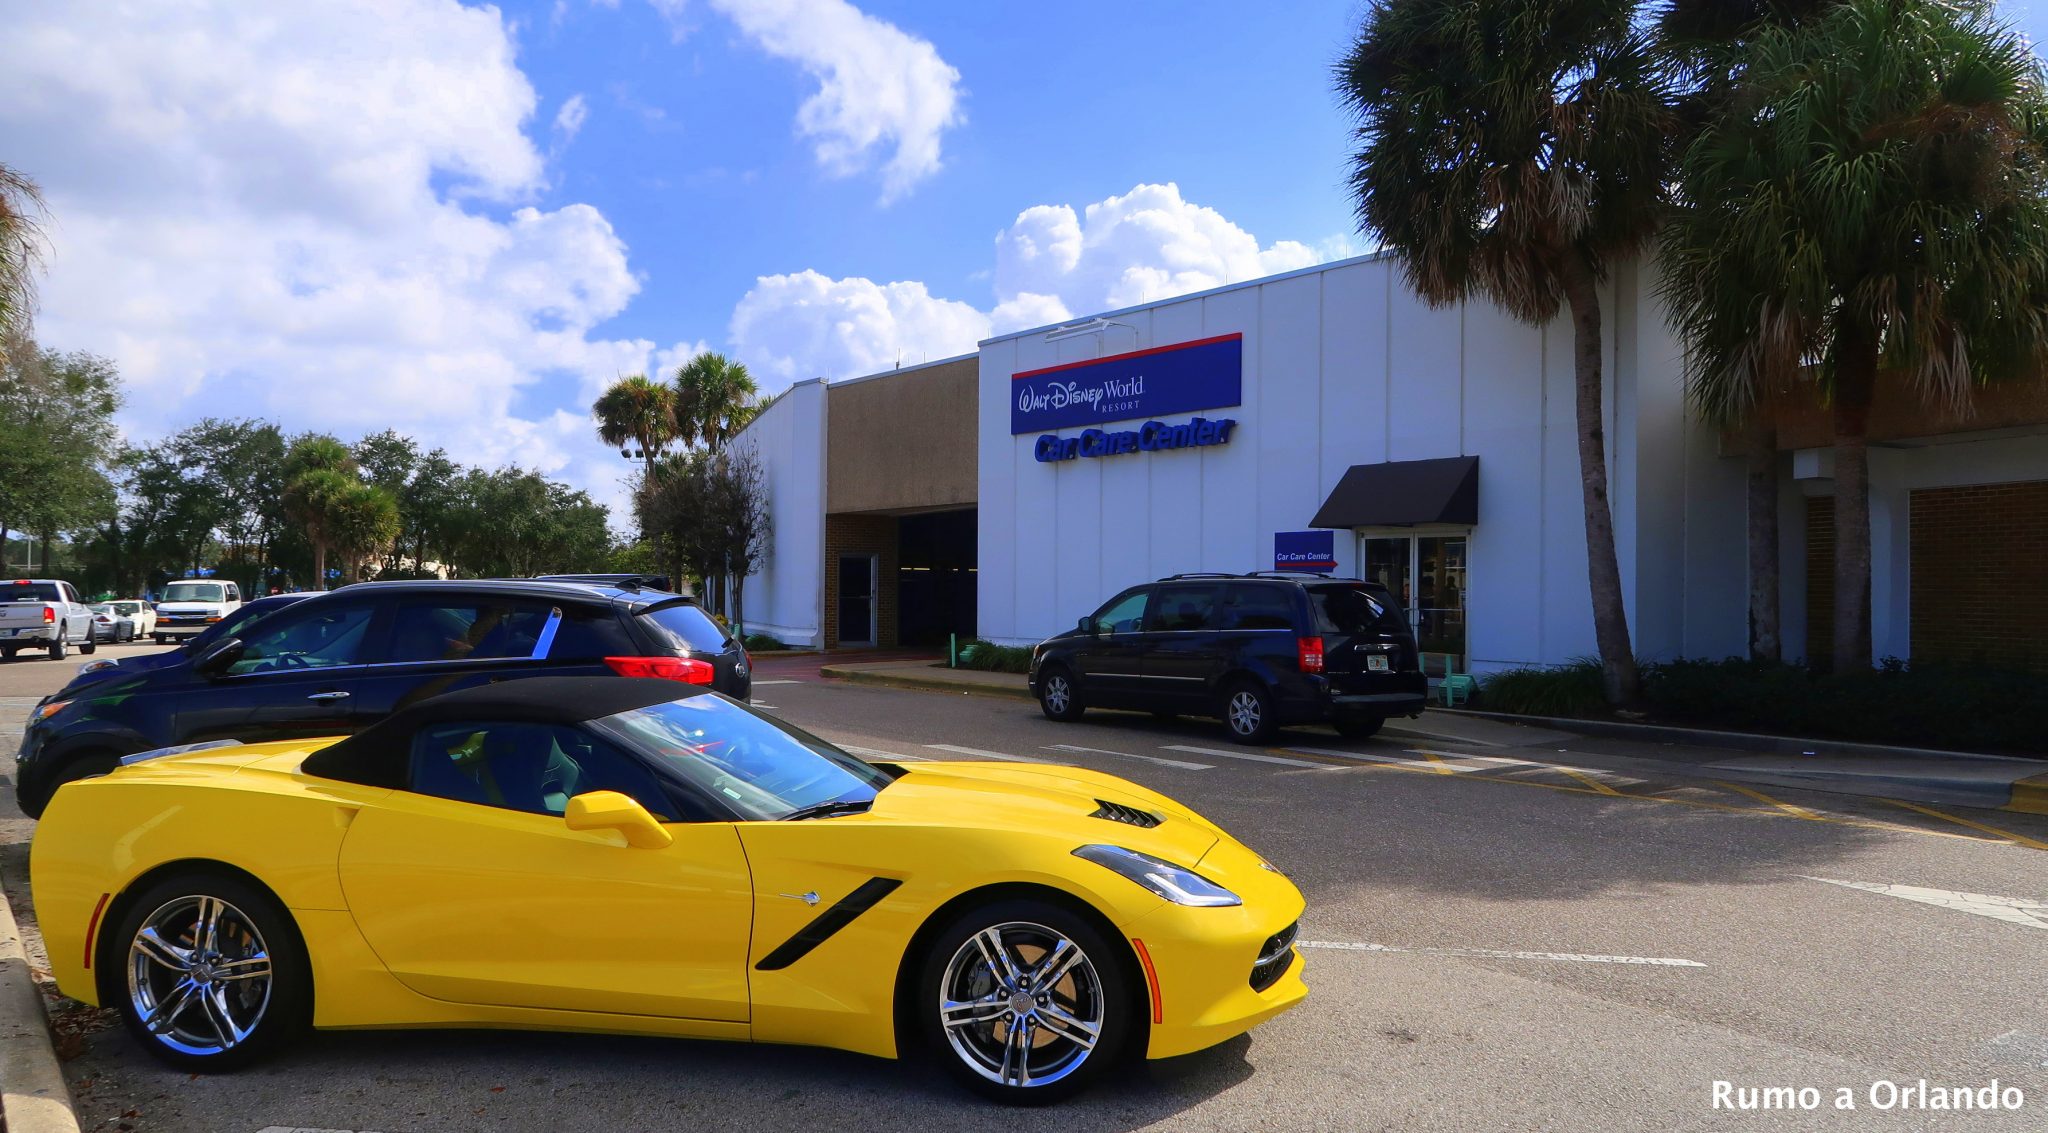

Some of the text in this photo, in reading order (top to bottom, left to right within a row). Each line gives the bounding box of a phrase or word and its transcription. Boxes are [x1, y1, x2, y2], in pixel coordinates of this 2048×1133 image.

[1104, 376, 1144, 399] World
[1102, 400, 1140, 413] RESORT
[1035, 417, 1236, 462] Car Care Center
[1307, 552, 1330, 560] Center
